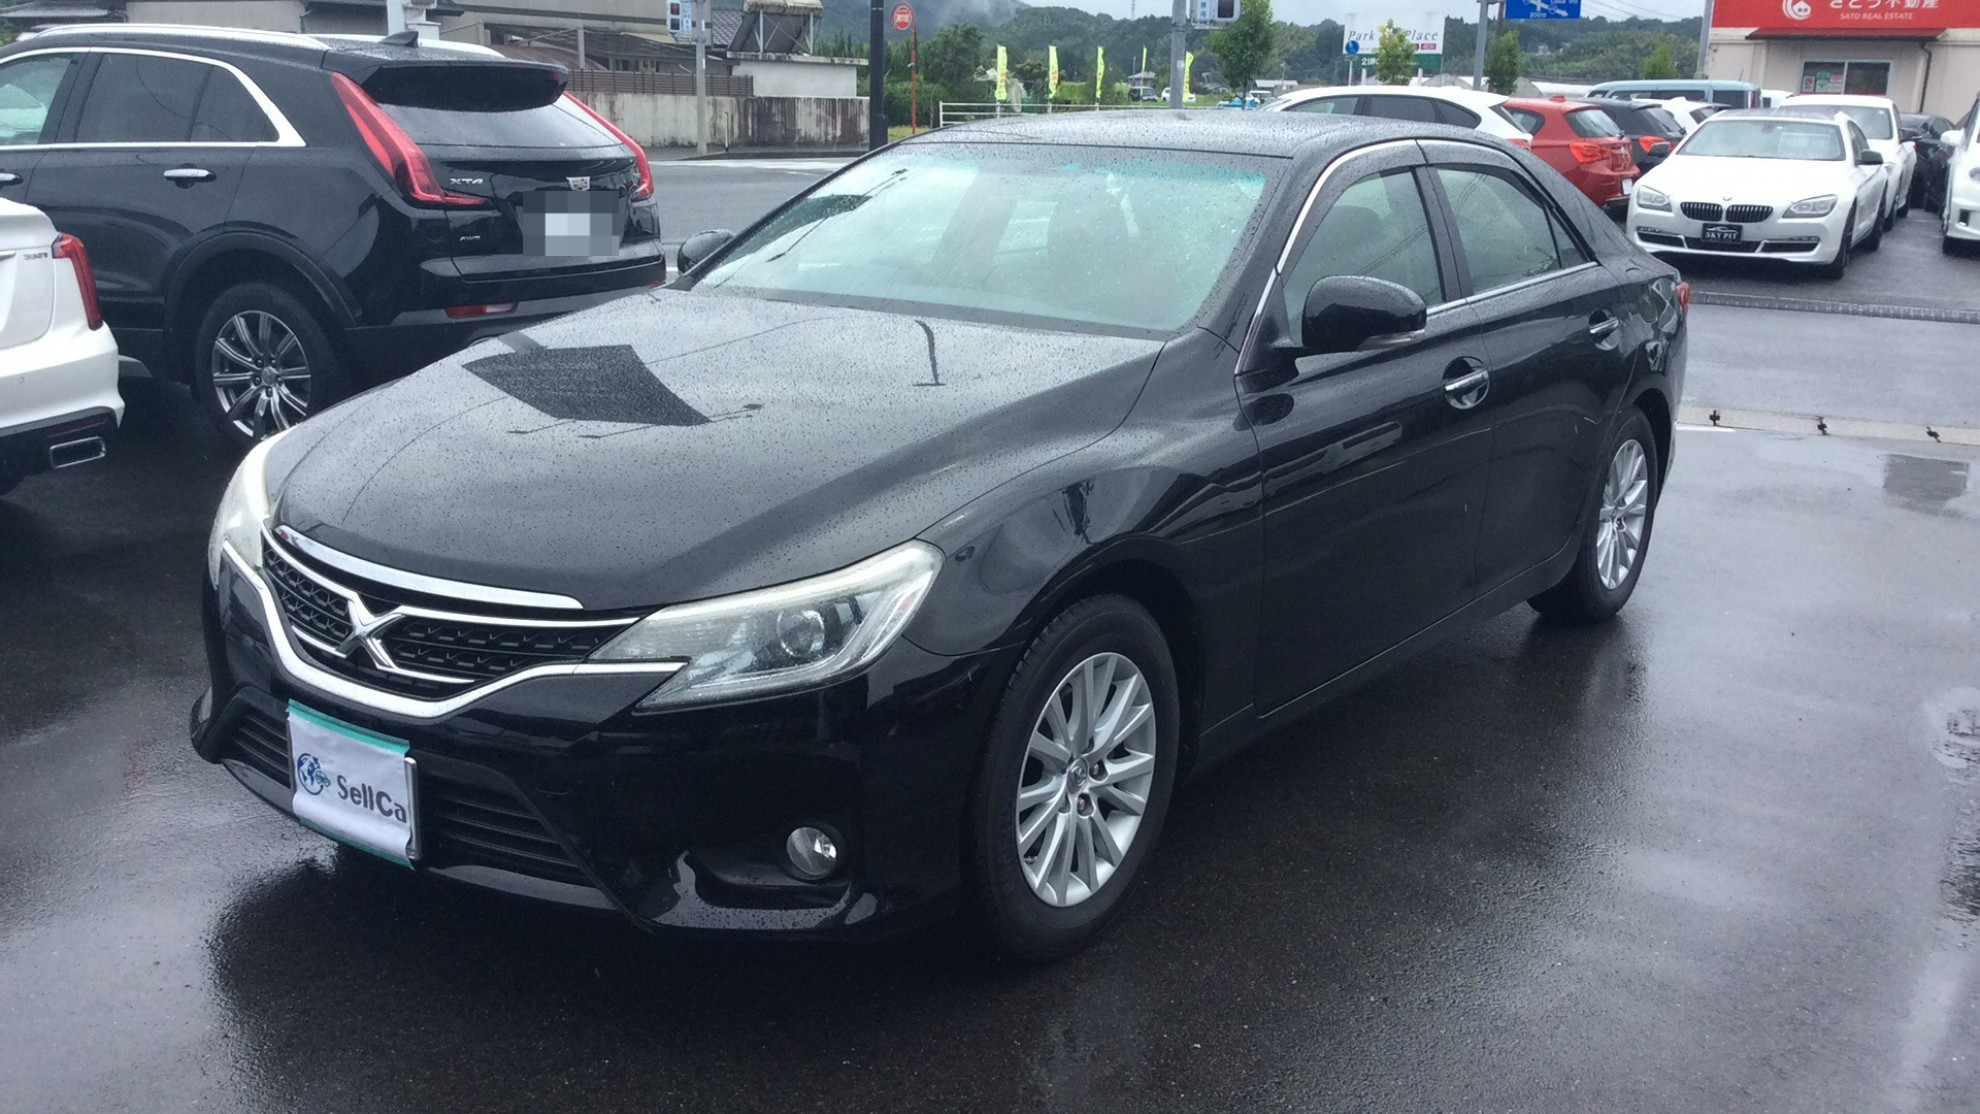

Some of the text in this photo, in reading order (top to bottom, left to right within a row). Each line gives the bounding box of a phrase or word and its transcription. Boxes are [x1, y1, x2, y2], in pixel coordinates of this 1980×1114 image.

[1840, 12, 1914, 20] SATO REAL ESTATE
[1348, 30, 1375, 41] Park
[1705, 231, 1722, 239] SKY
[337, 774, 408, 824] SellCa
